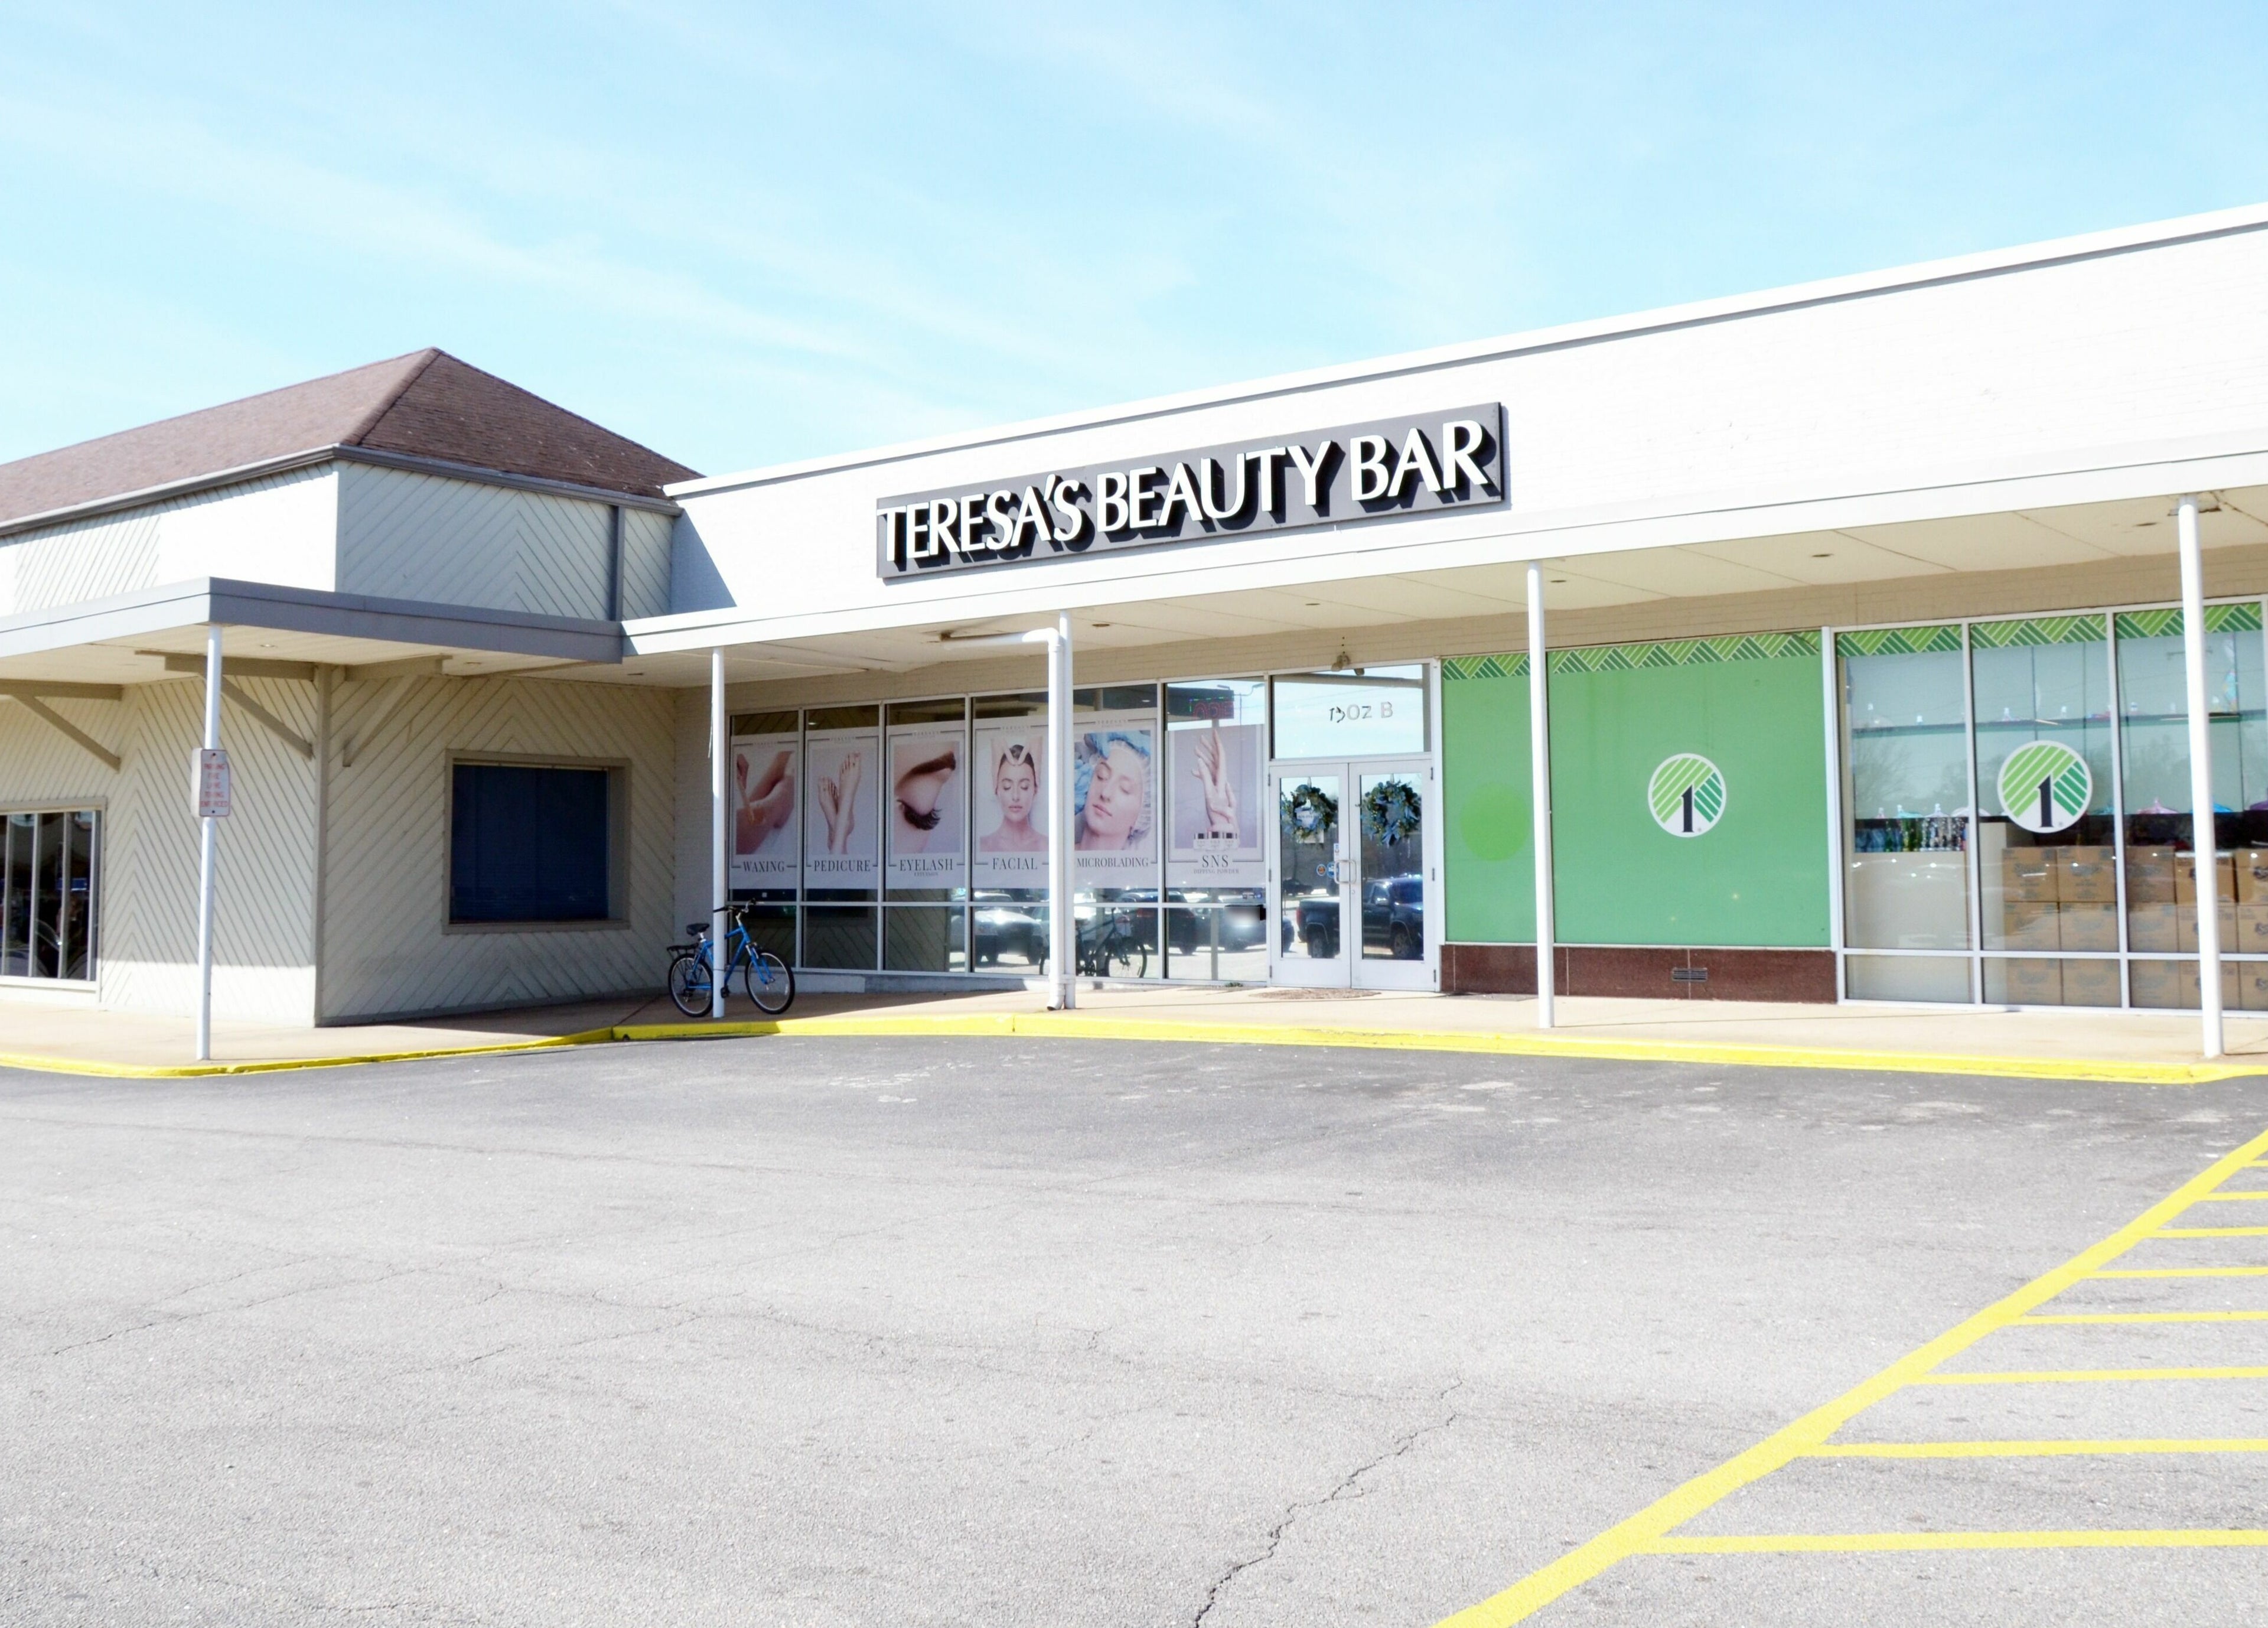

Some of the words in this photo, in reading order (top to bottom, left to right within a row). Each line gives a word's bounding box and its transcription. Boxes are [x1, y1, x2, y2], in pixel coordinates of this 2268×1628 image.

[876, 473, 1081, 561] TERESA'S
[1096, 440, 1330, 533] BEAUTY
[1350, 419, 1491, 501] BAR
[1381, 701, 1393, 718] B
[742, 861, 785, 872] WAXING
[814, 859, 871, 872] PEDICURE
[900, 858, 953, 871] EYELASH
[992, 857, 1038, 870] FACIAL
[1077, 857, 1149, 868] MICROBLADING
[1202, 855, 1229, 868] SNS
